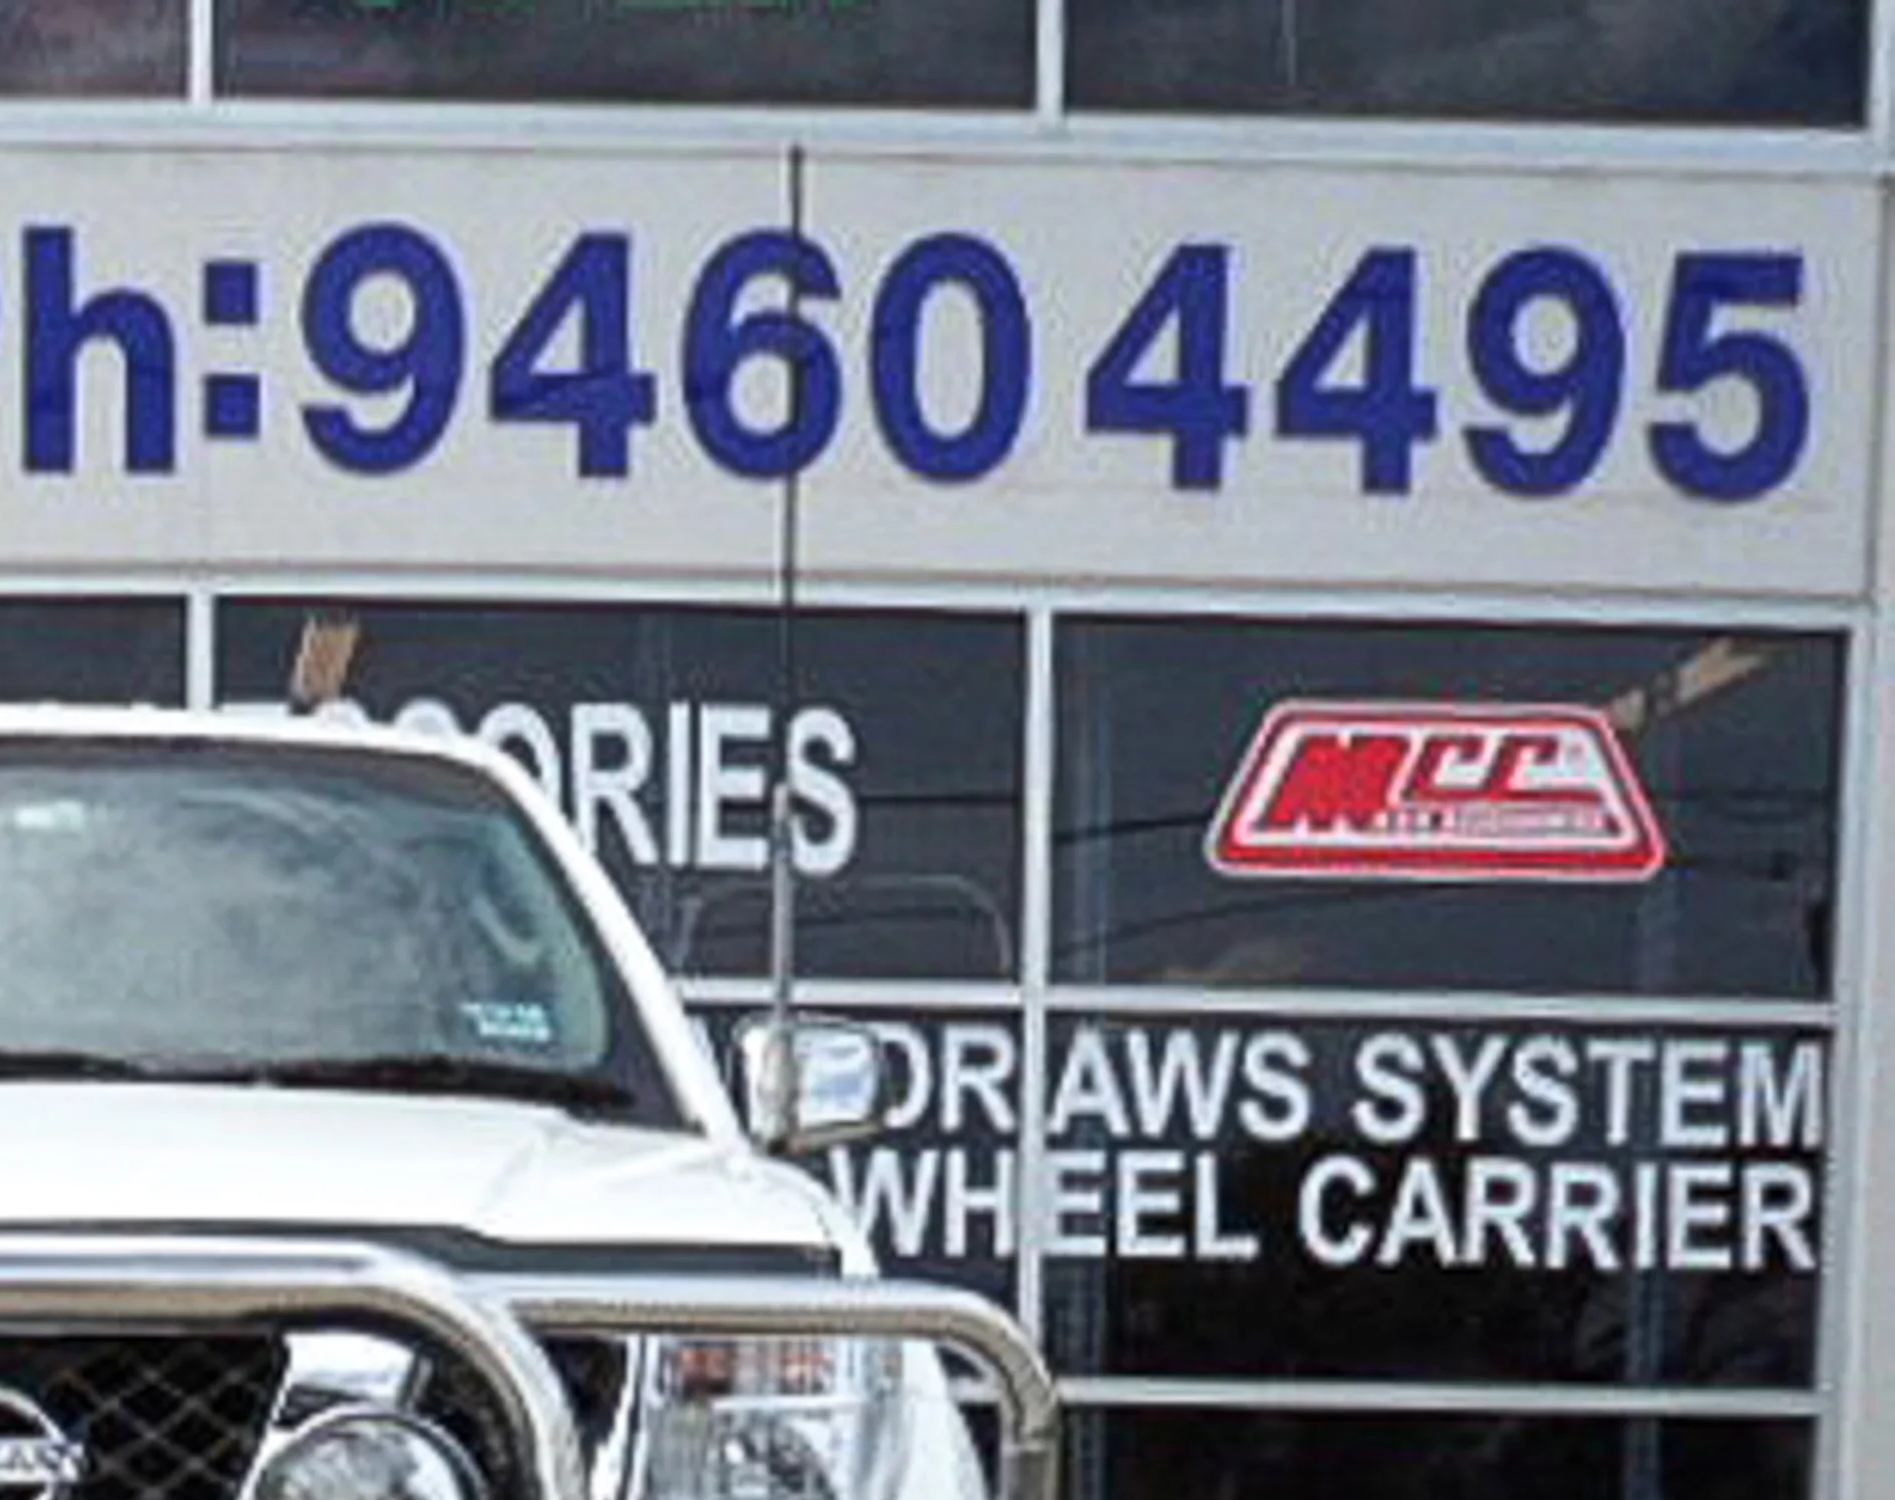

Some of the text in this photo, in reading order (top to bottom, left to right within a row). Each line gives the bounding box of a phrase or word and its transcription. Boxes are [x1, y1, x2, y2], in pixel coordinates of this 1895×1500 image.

[1083, 243, 1811, 504] 4495
[1351, 1031, 1823, 1149] SYSTEM
[828, 1146, 1818, 1271] WHEEL CARRIER
